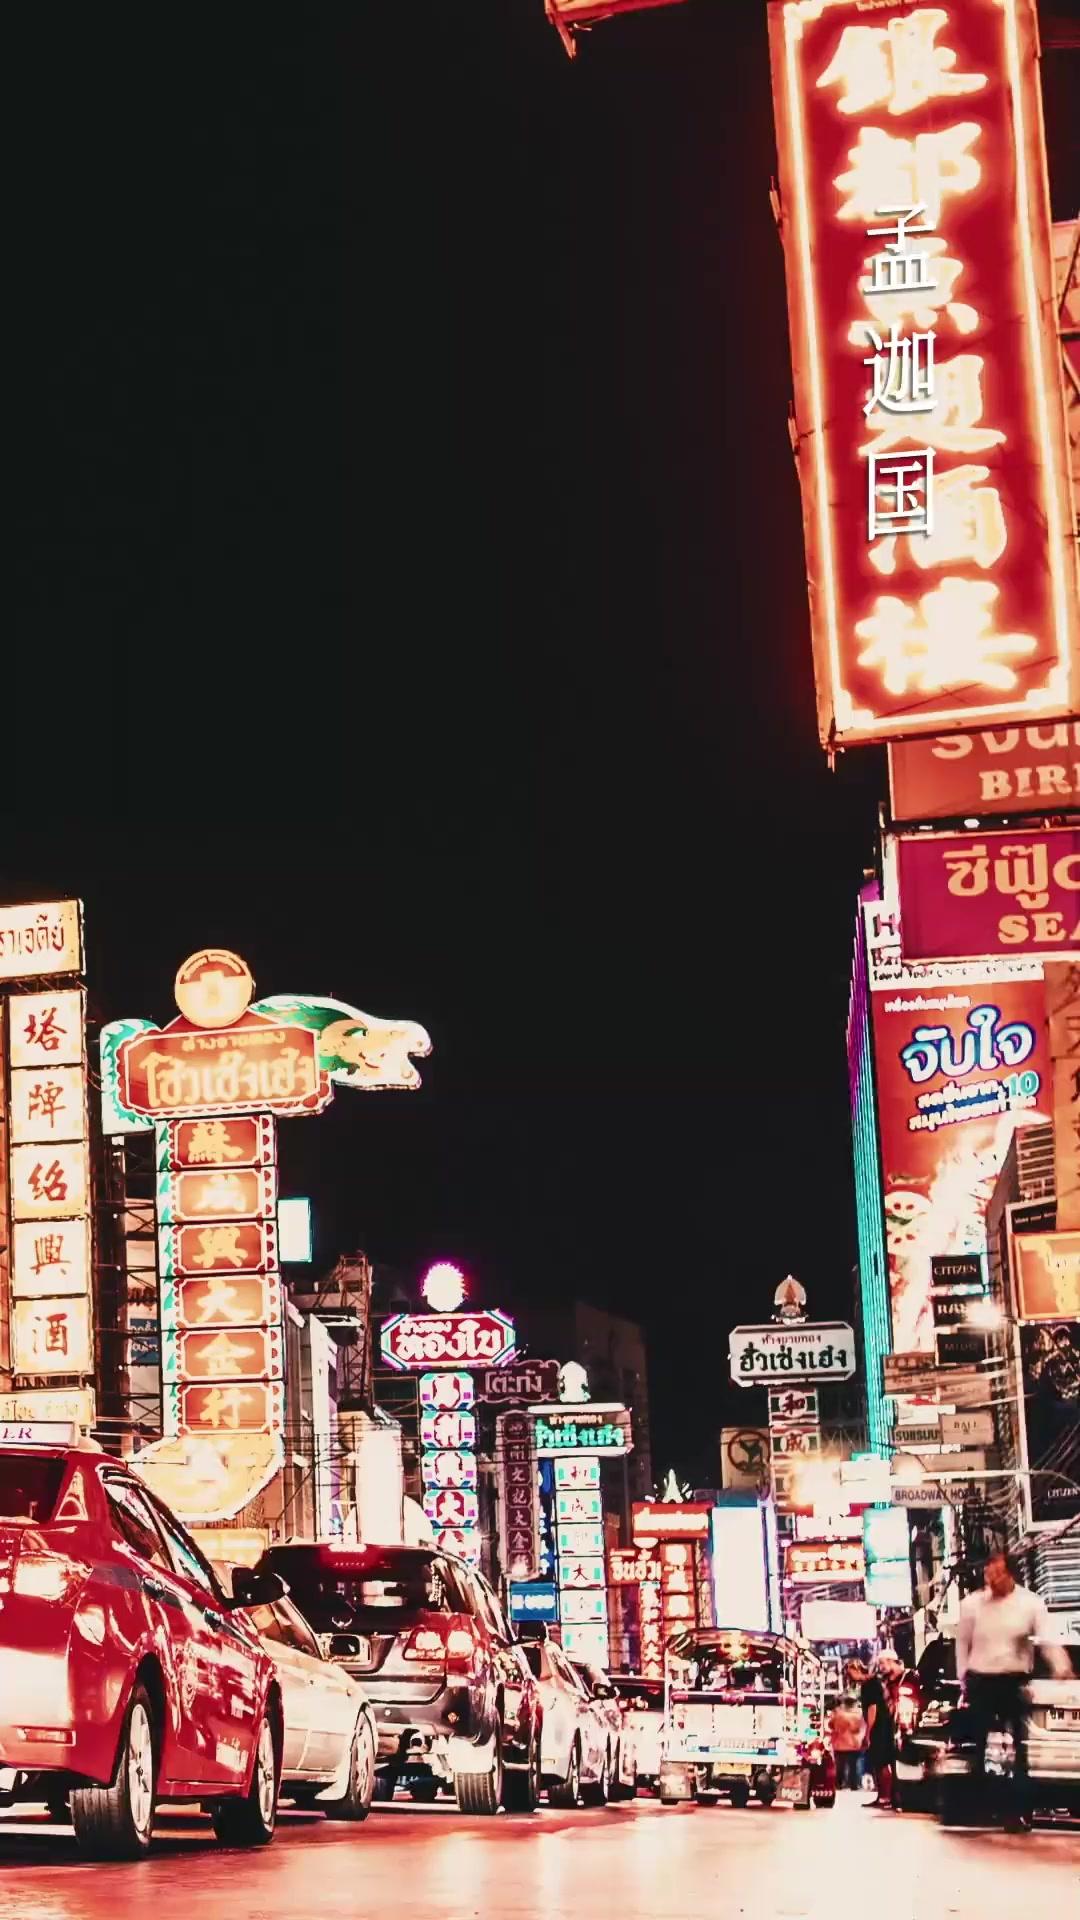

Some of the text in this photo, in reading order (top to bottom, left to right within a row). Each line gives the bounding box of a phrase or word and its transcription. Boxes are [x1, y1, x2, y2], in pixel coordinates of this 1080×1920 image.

[979, 763, 1080, 801] BIR
[998, 913, 1080, 944] SE
[902, 1005, 1034, 1083] จับใจ
[1003, 1070, 1040, 1098] 10
[934, 1264, 977, 1276] CITIZEN
